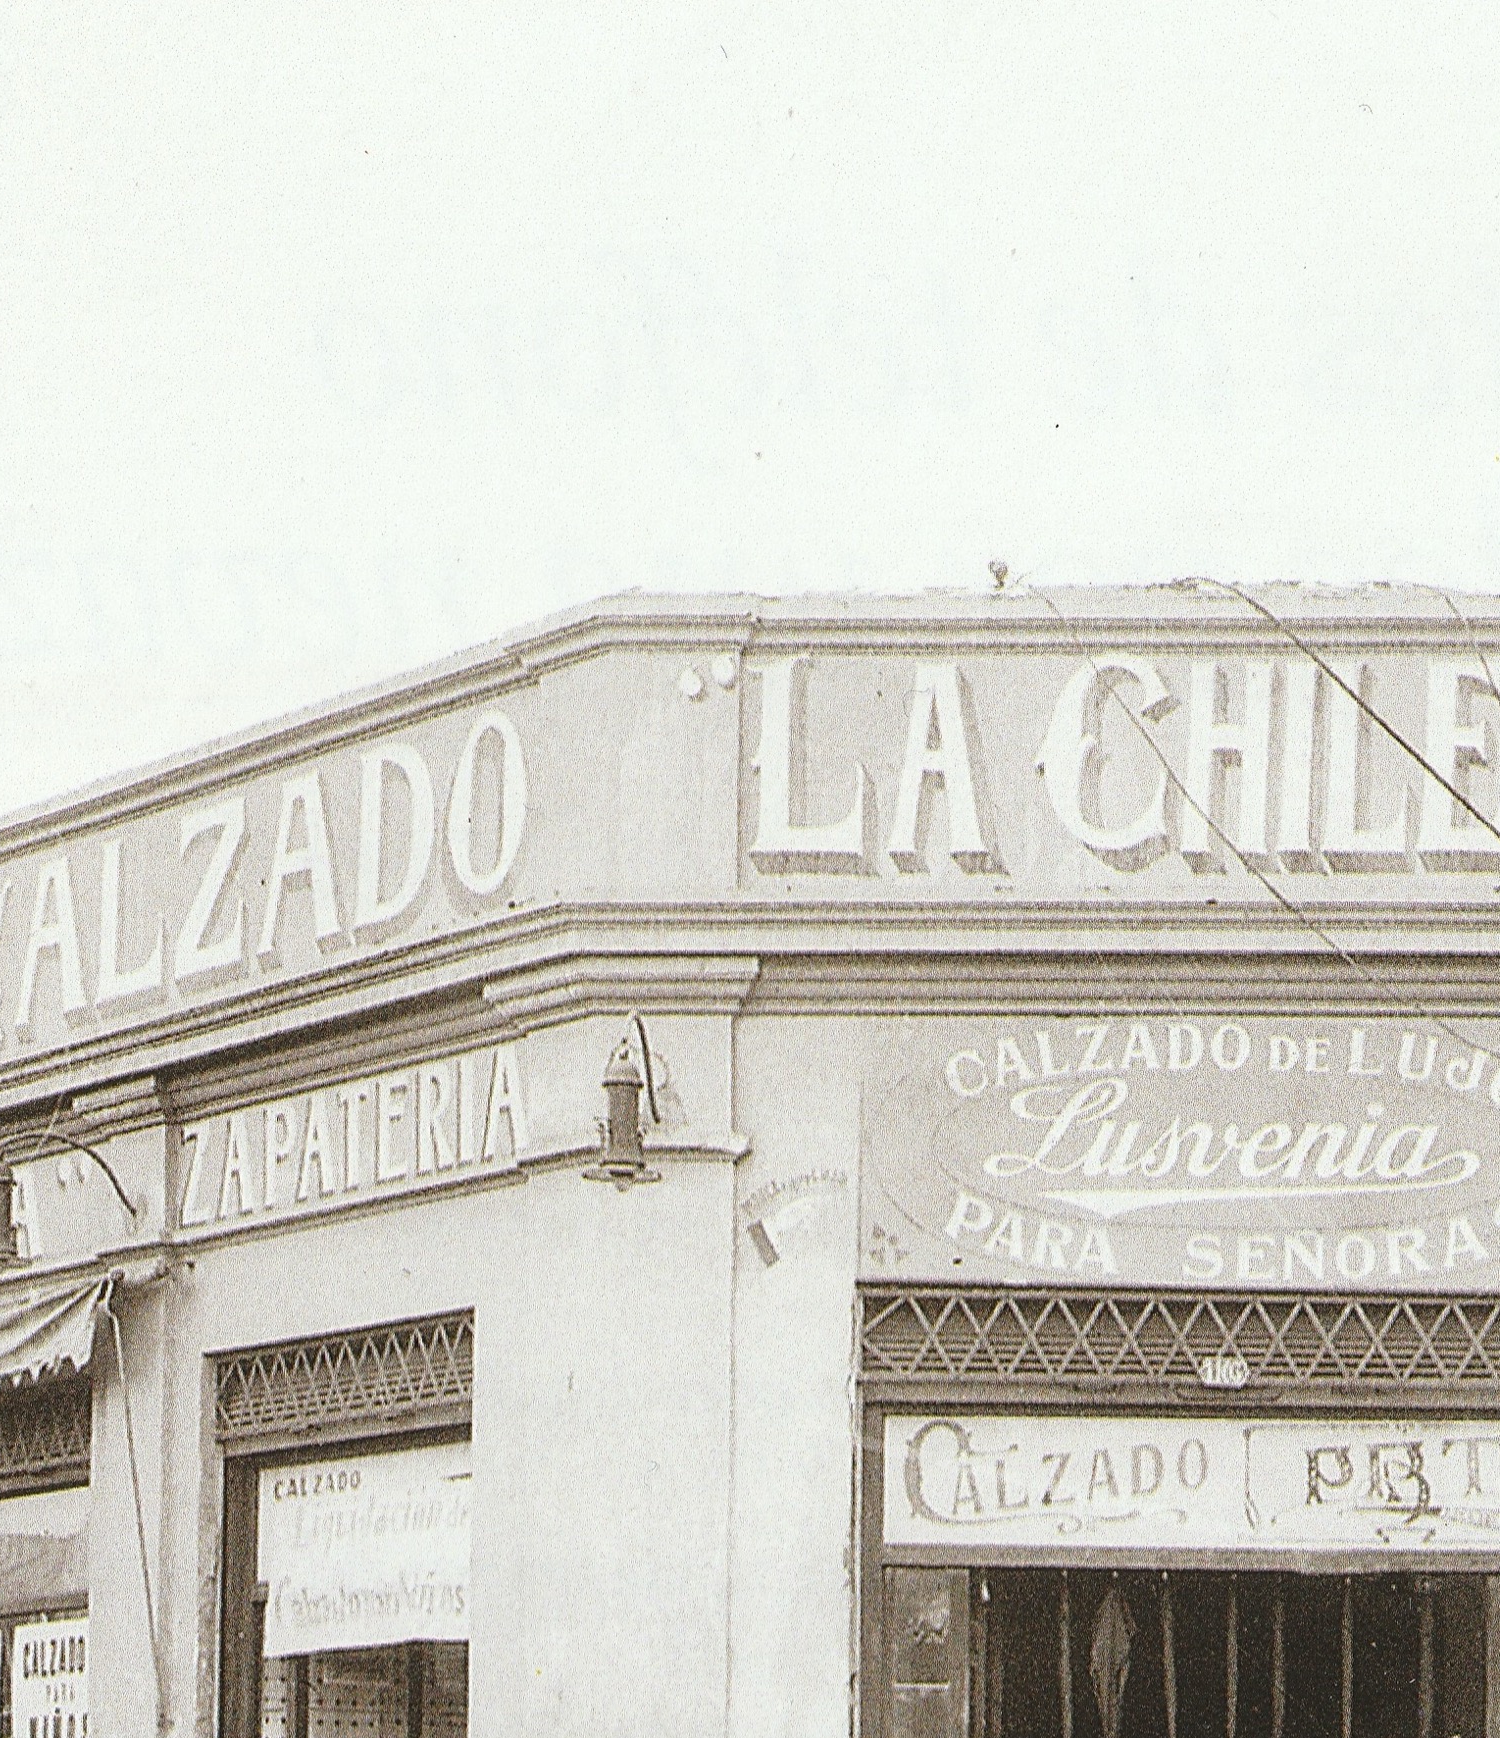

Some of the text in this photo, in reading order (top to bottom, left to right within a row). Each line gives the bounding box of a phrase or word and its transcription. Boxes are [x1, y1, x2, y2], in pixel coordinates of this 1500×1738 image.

[946, 1024, 1250, 1099] CALZADO
[1269, 1034, 1333, 1073] DE
[182, 1043, 528, 1229] ZAPATERIA
[946, 1191, 1122, 1278] PARA
[273, 1468, 364, 1503] CALZADO
[904, 1419, 1210, 1524] CALZADO
[22, 1634, 88, 1680] CALZADO
